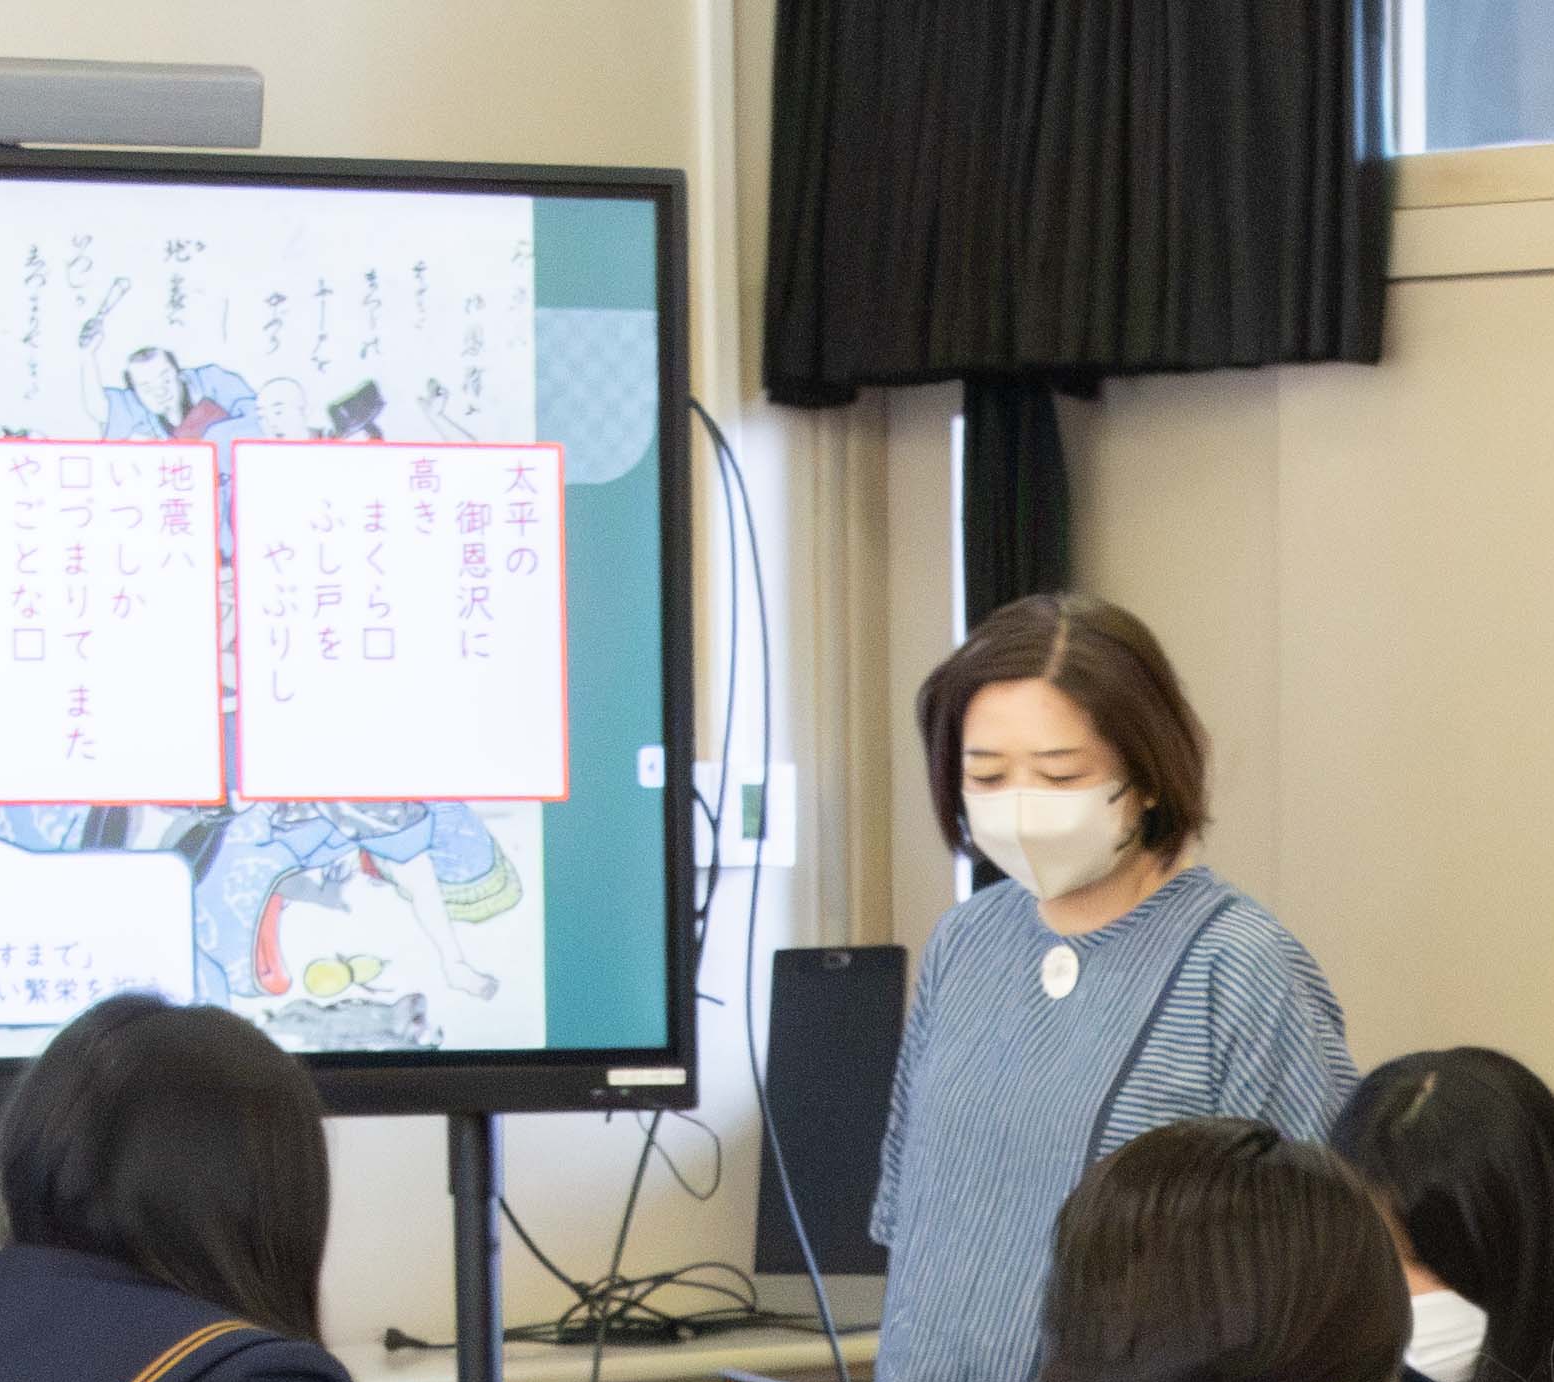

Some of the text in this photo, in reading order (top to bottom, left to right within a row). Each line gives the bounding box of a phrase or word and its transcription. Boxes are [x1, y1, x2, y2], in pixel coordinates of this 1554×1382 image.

[109, 460, 144, 619] いつしか
[409, 457, 441, 535] 高き
[505, 462, 540, 576] 太平の
[263, 543, 298, 703] やぶりし
[310, 500, 345, 661] ふし戸を
[455, 500, 495, 660] 御恩沢に
